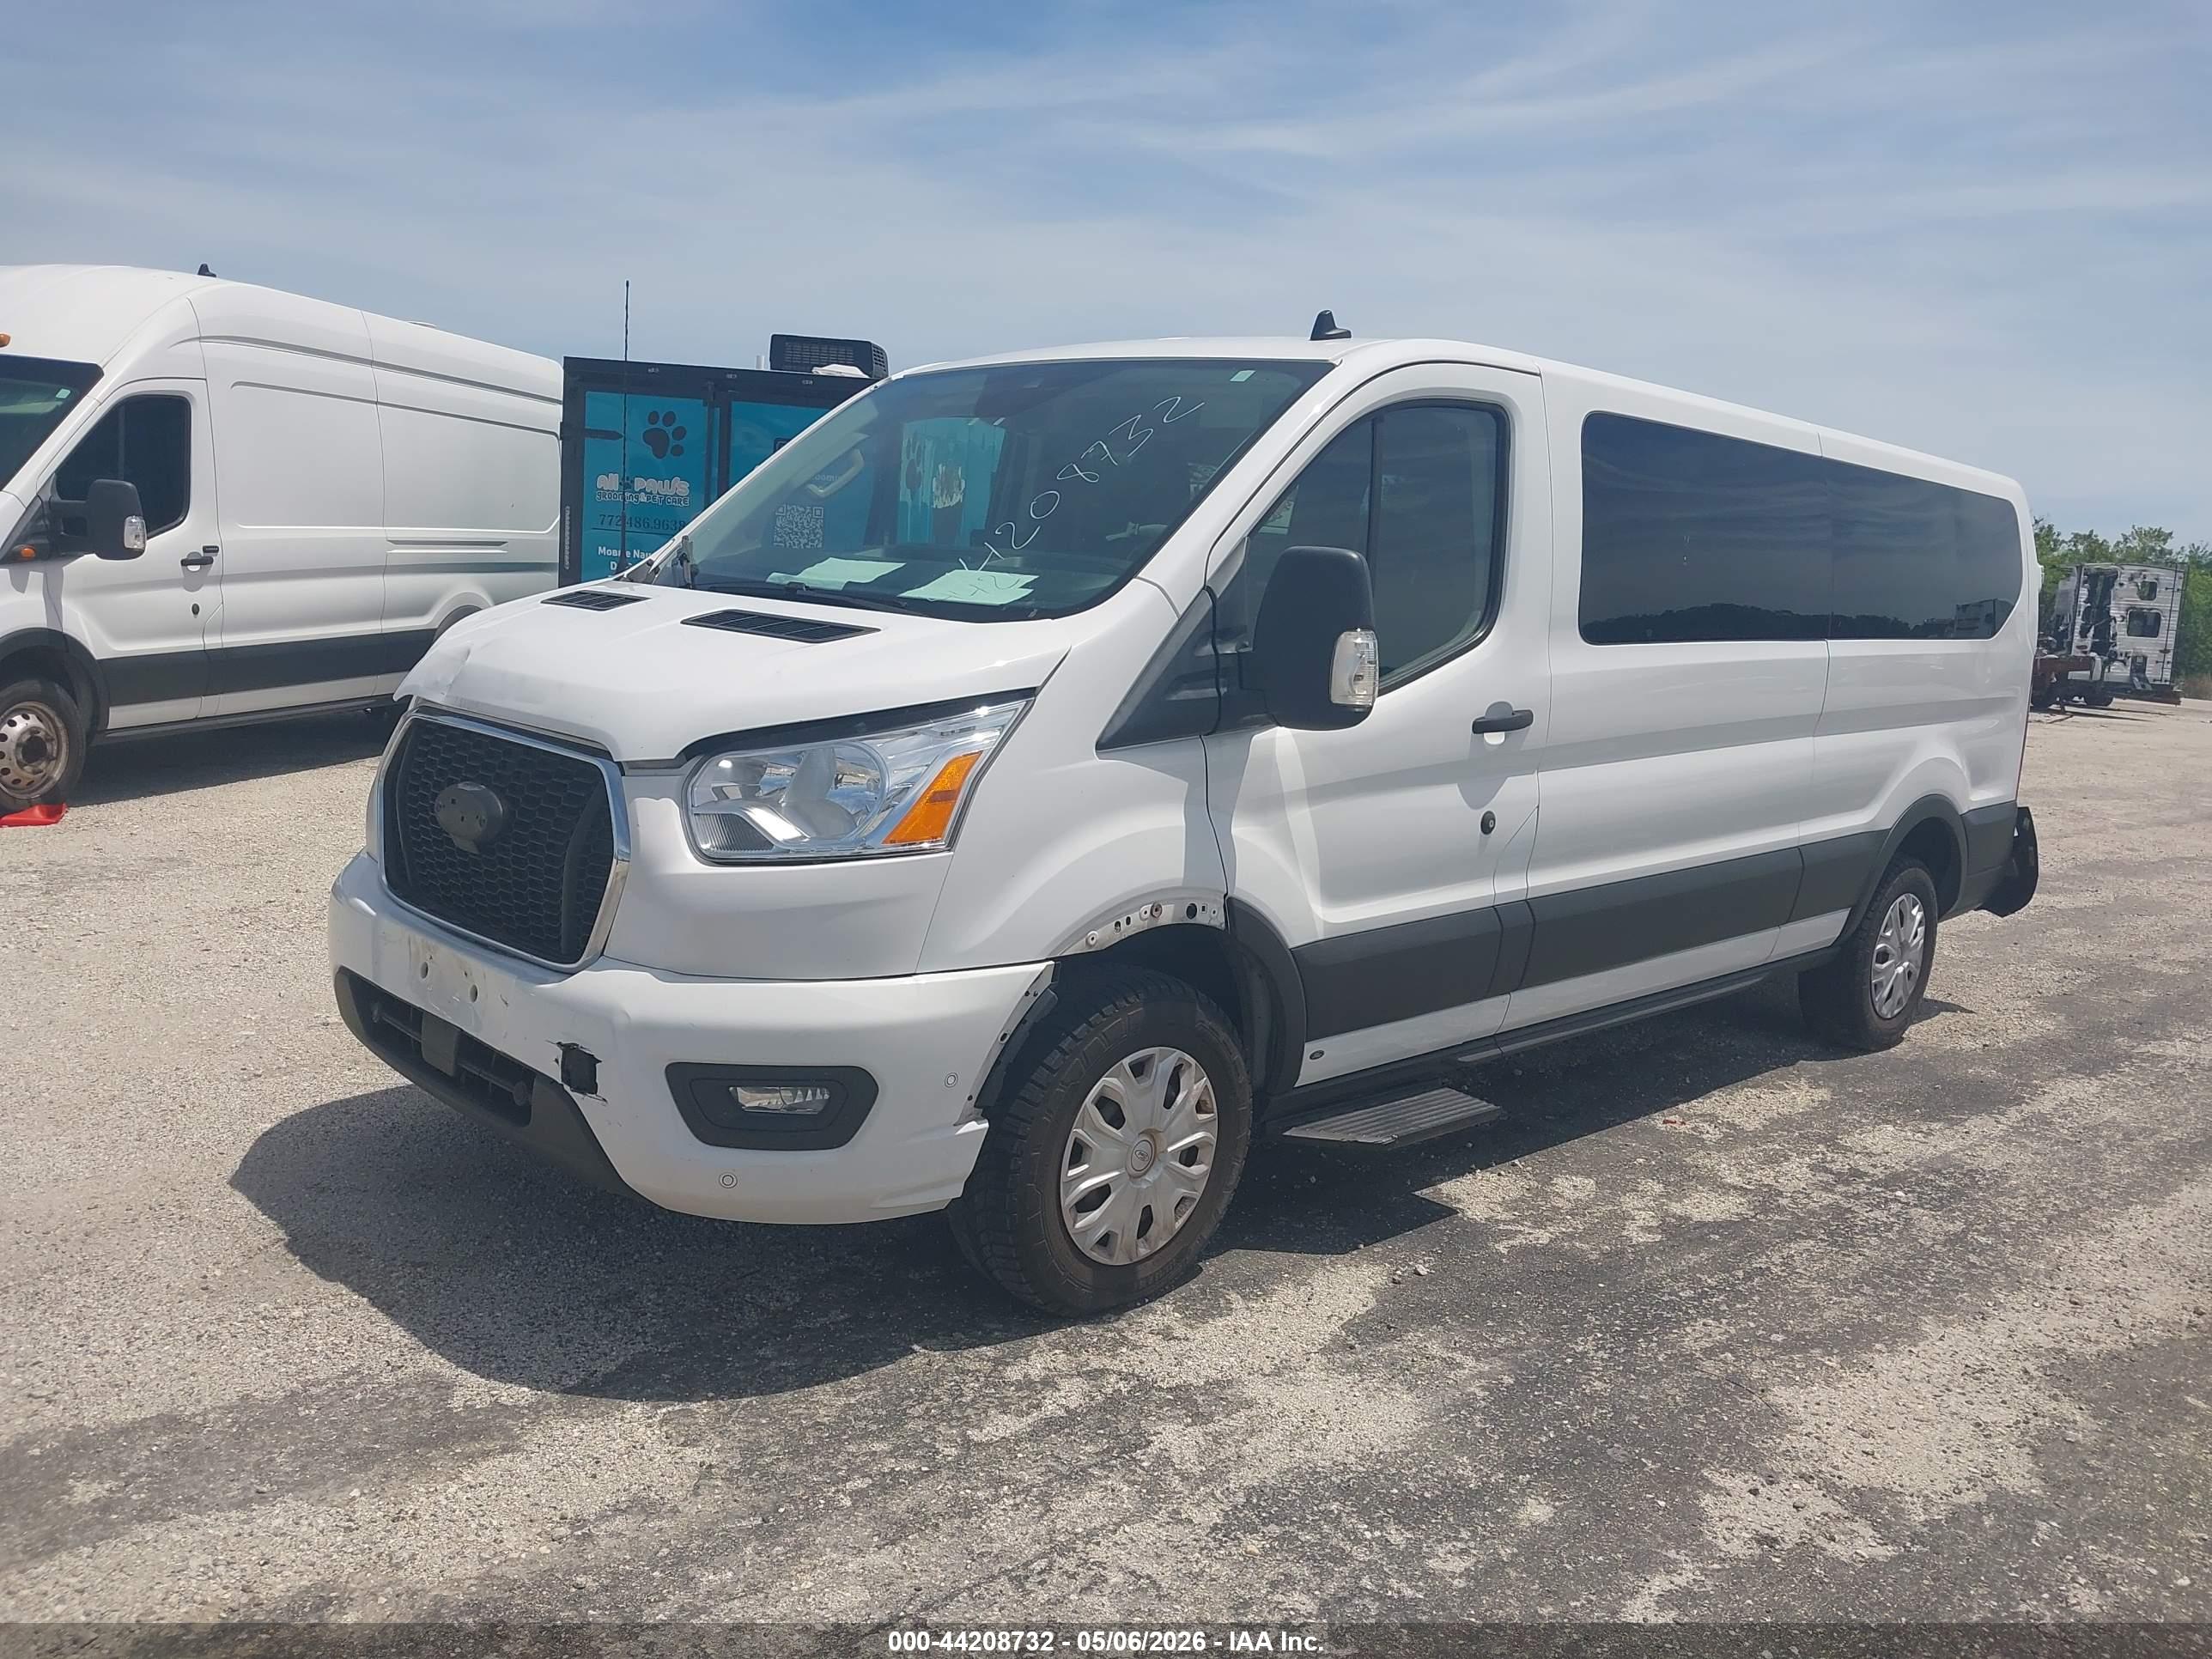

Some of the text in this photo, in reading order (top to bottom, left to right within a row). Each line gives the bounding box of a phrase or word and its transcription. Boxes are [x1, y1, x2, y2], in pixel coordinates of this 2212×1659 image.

[958, 396, 1205, 574] 4208732
[665, 495, 690, 507] CARE
[599, 514, 686, 531] 772486.9638
